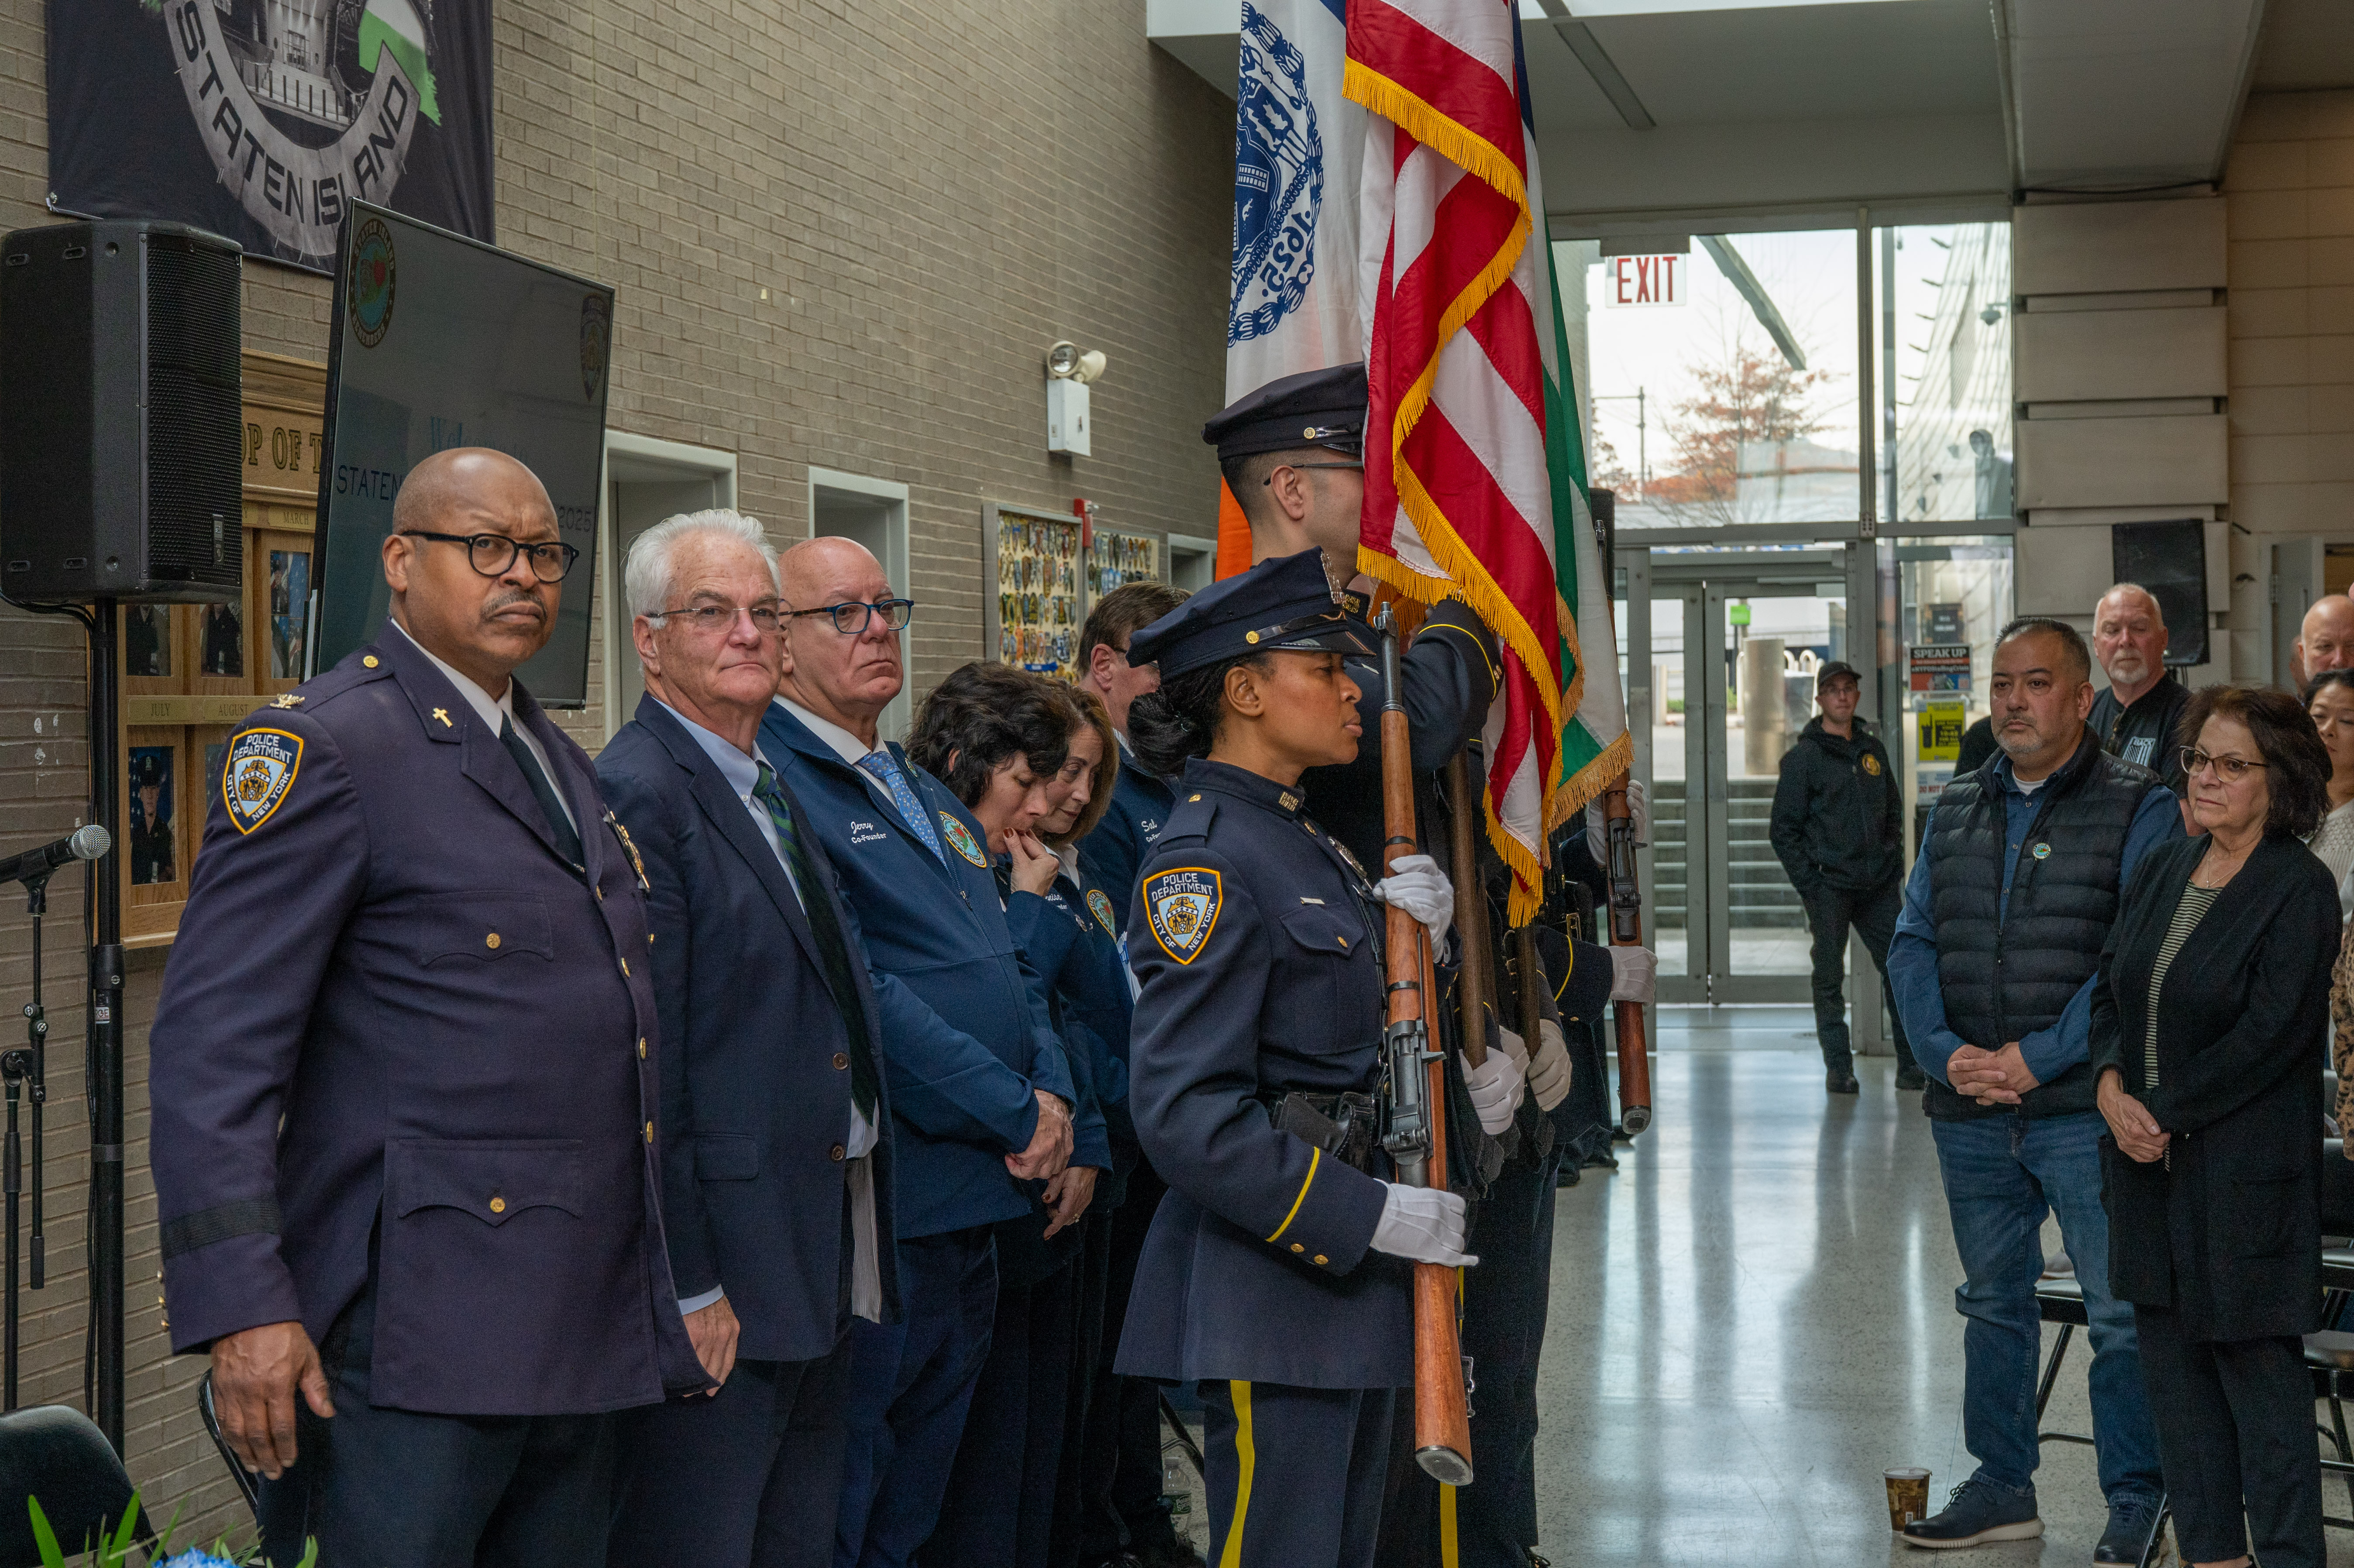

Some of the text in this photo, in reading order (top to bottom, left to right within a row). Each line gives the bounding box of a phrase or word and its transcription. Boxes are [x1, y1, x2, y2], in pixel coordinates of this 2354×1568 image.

[176, 1, 407, 226] STATEN ISLAND
[1617, 256, 1677, 303] EXIT
[272, 426, 302, 471] OF
[336, 464, 592, 532] STATEN 2025
[283, 511, 309, 525] MARCH
[1913, 648, 1967, 658] SPEAK UP
[151, 703, 171, 717] JULY
[218, 704, 249, 717] AUGUST
[246, 734, 280, 747] POLICE
[232, 745, 293, 764] DEPARTMENT
[232, 802, 241, 814] OF
[251, 801, 271, 821] NEW
[270, 771, 292, 800] YORK
[850, 821, 873, 835] Jerry
[1141, 818, 1157, 832] Sal
[851, 832, 886, 843] Co-Founder
[1163, 873, 1198, 887] POLICE
[1151, 883, 1214, 902] DEPARTMENT
[1153, 902, 1216, 951] CITY OF NEW YORK
